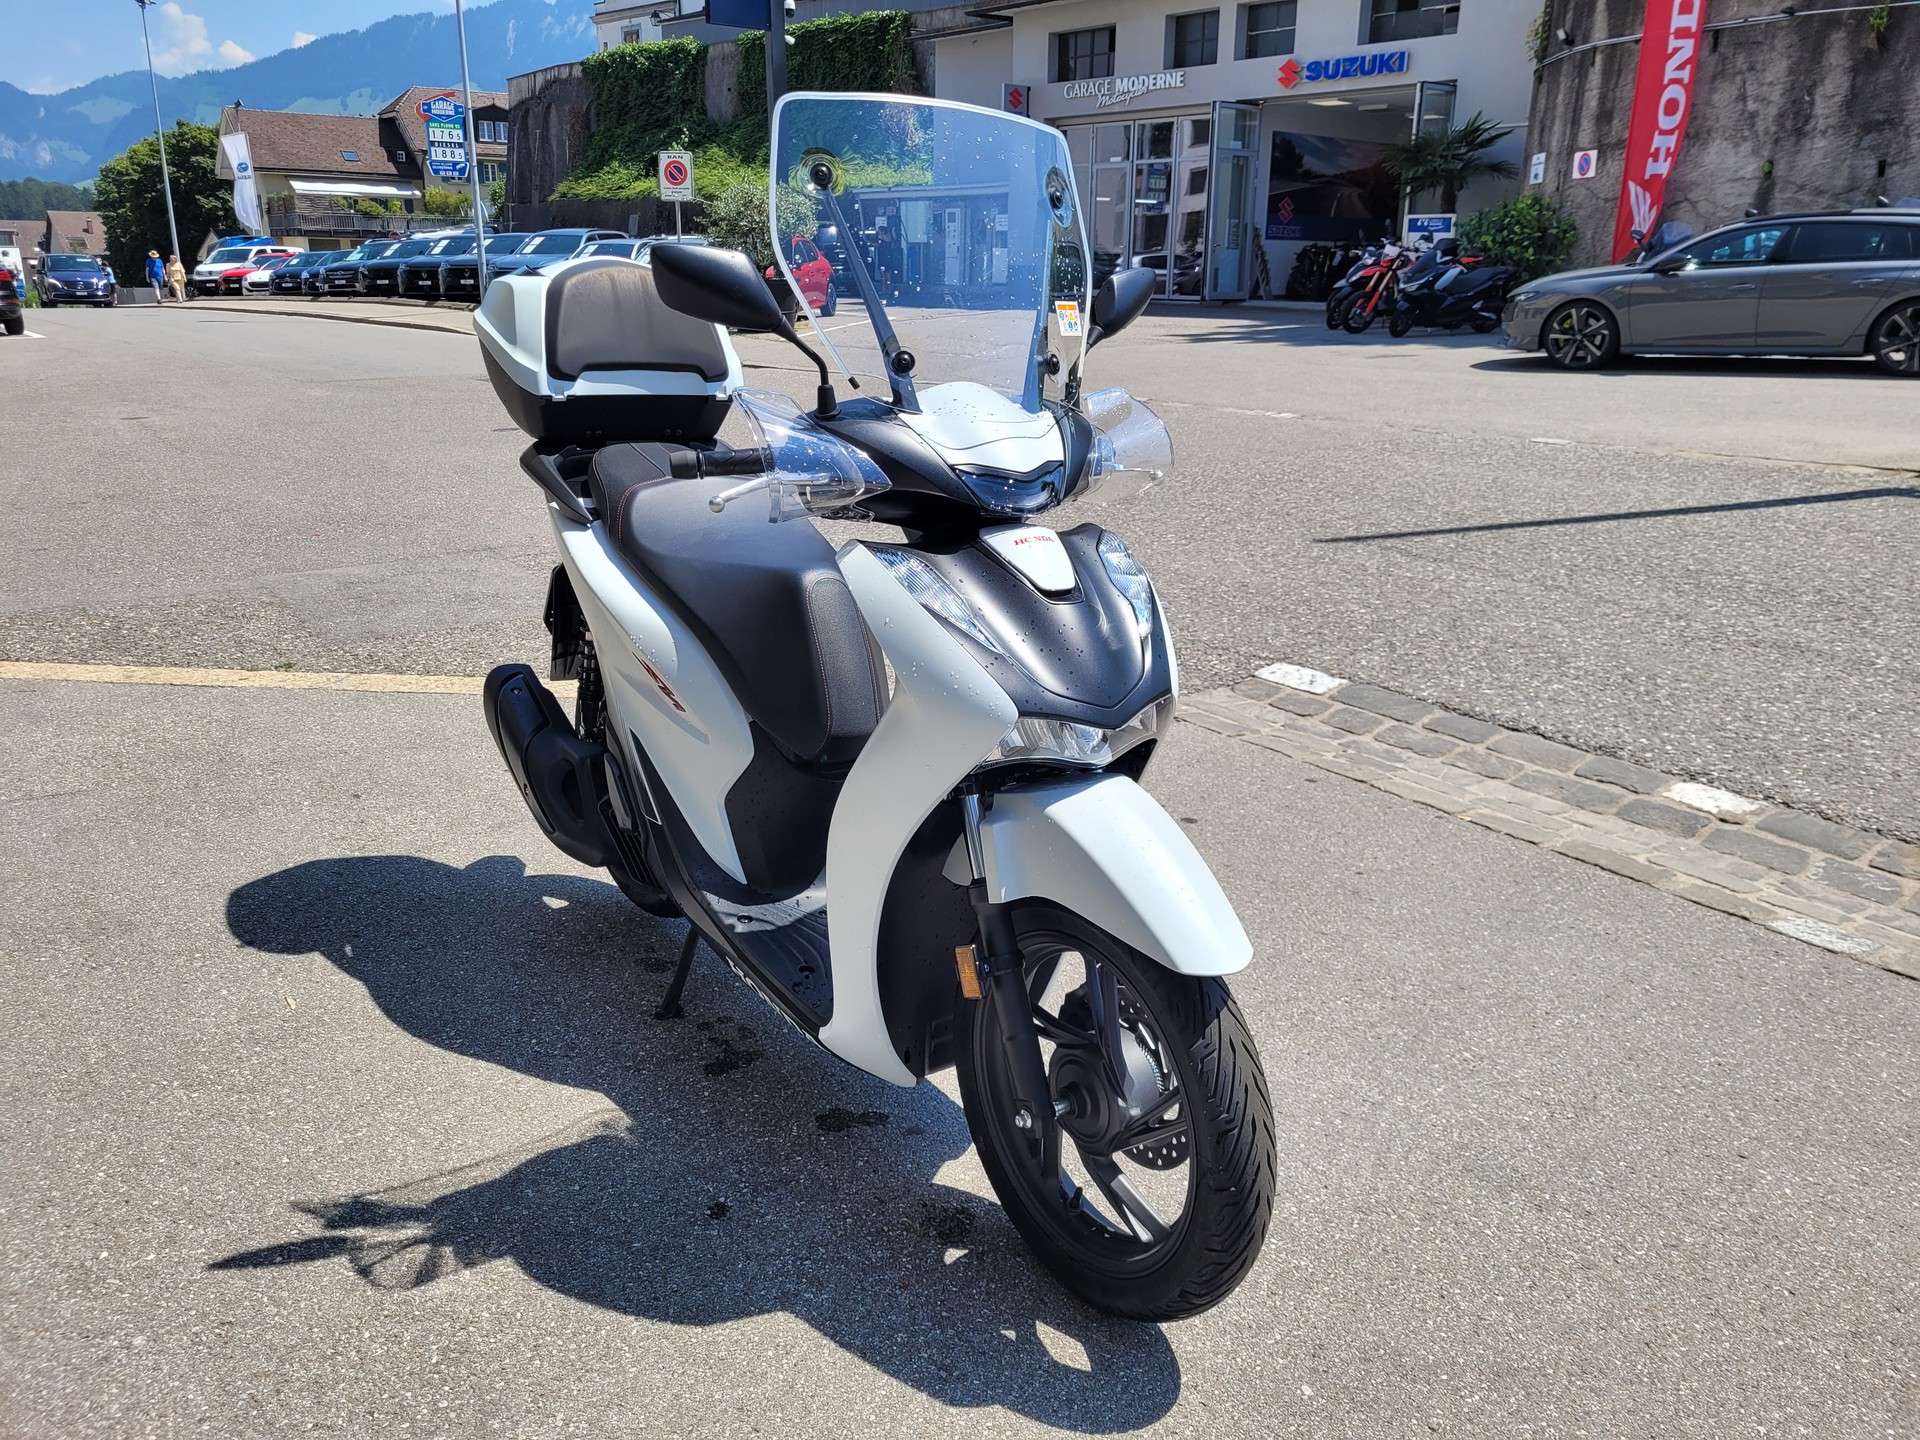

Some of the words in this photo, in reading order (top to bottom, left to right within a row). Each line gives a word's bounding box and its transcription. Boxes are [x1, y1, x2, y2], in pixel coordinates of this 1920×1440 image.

[1305, 51, 1408, 82] SUZUKI
[1063, 79, 1112, 99] GARAGE
[1115, 71, 1185, 93] MODERNE
[431, 101, 455, 110] GARAGE
[1268, 225, 1301, 237] SUZUKI
[1013, 535, 1055, 546] HONDA
